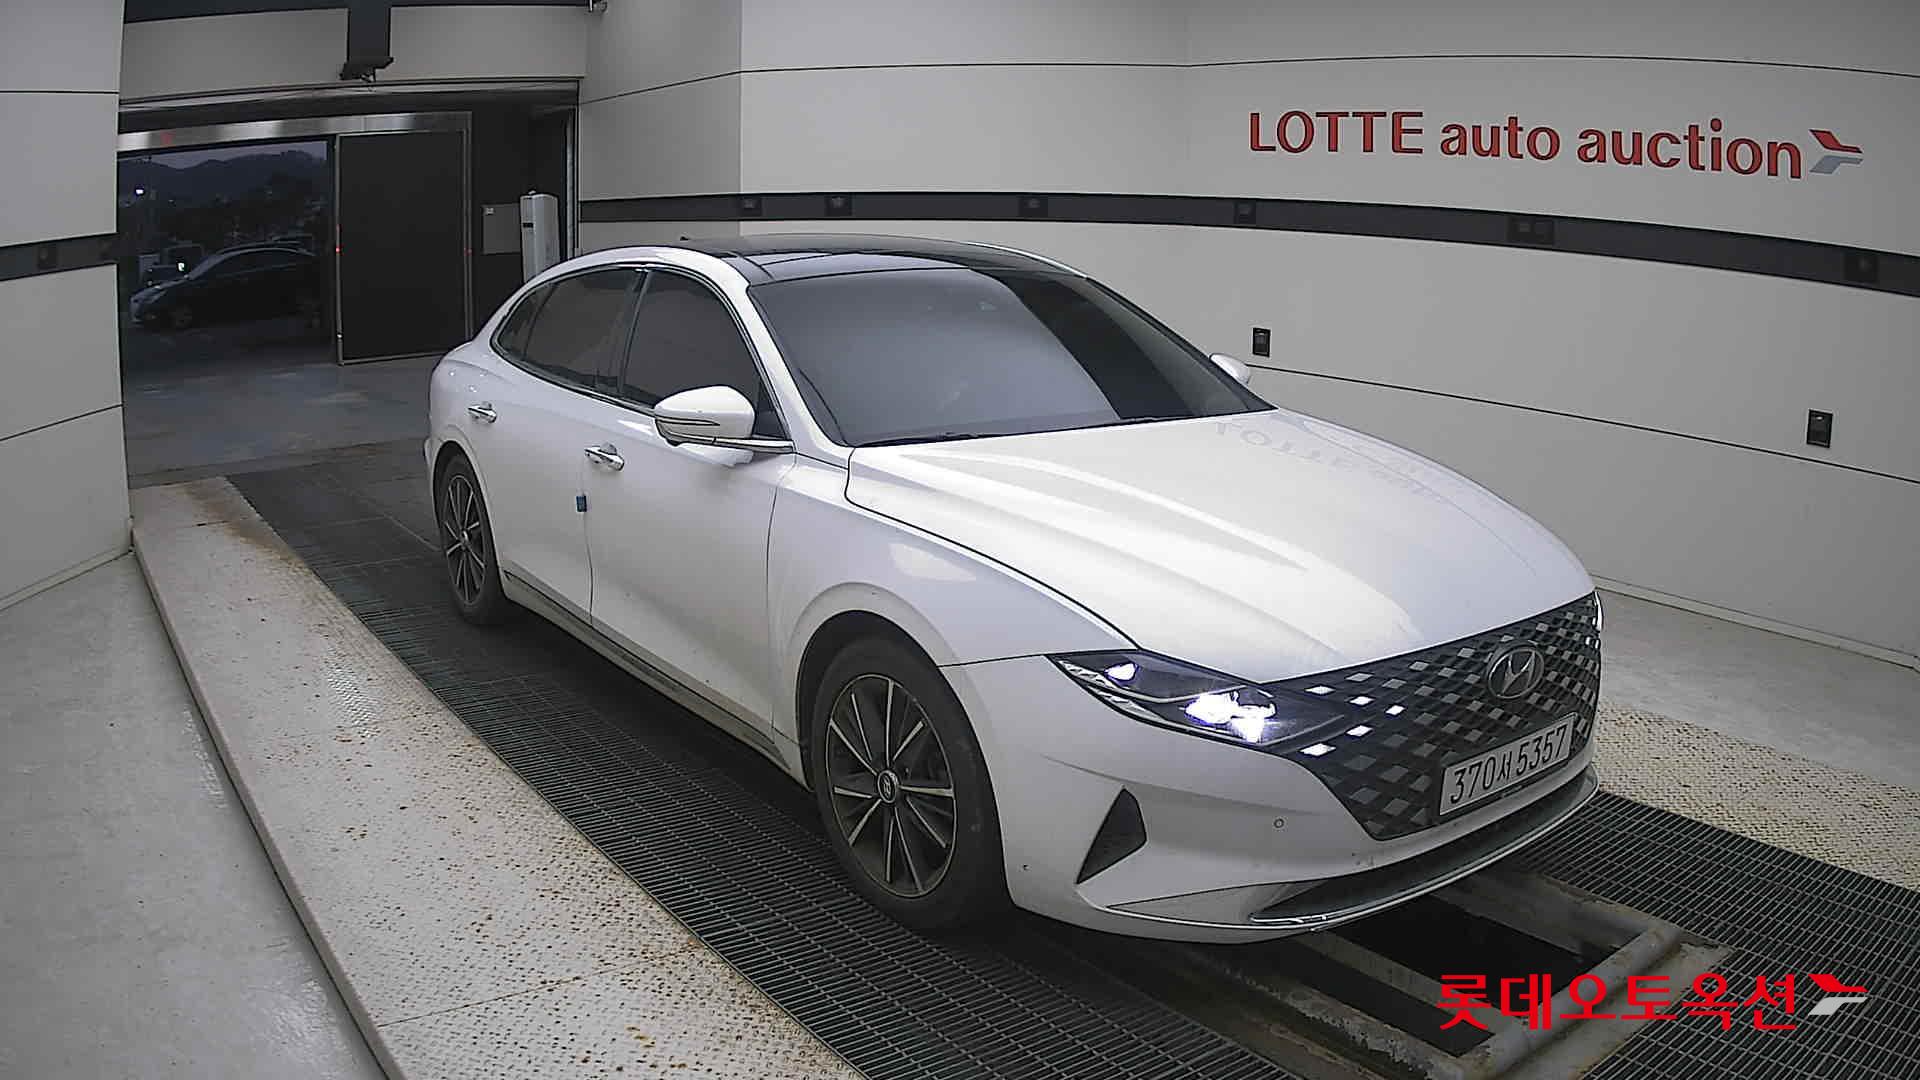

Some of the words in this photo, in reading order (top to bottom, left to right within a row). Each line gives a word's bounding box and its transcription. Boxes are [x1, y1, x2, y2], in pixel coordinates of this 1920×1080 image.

[1249, 110, 1424, 155] LOTTE
[1440, 116, 1561, 161] auto
[1576, 118, 1803, 179] auction
[1450, 750, 1513, 804] 370서
[1516, 724, 1567, 777] 5357
